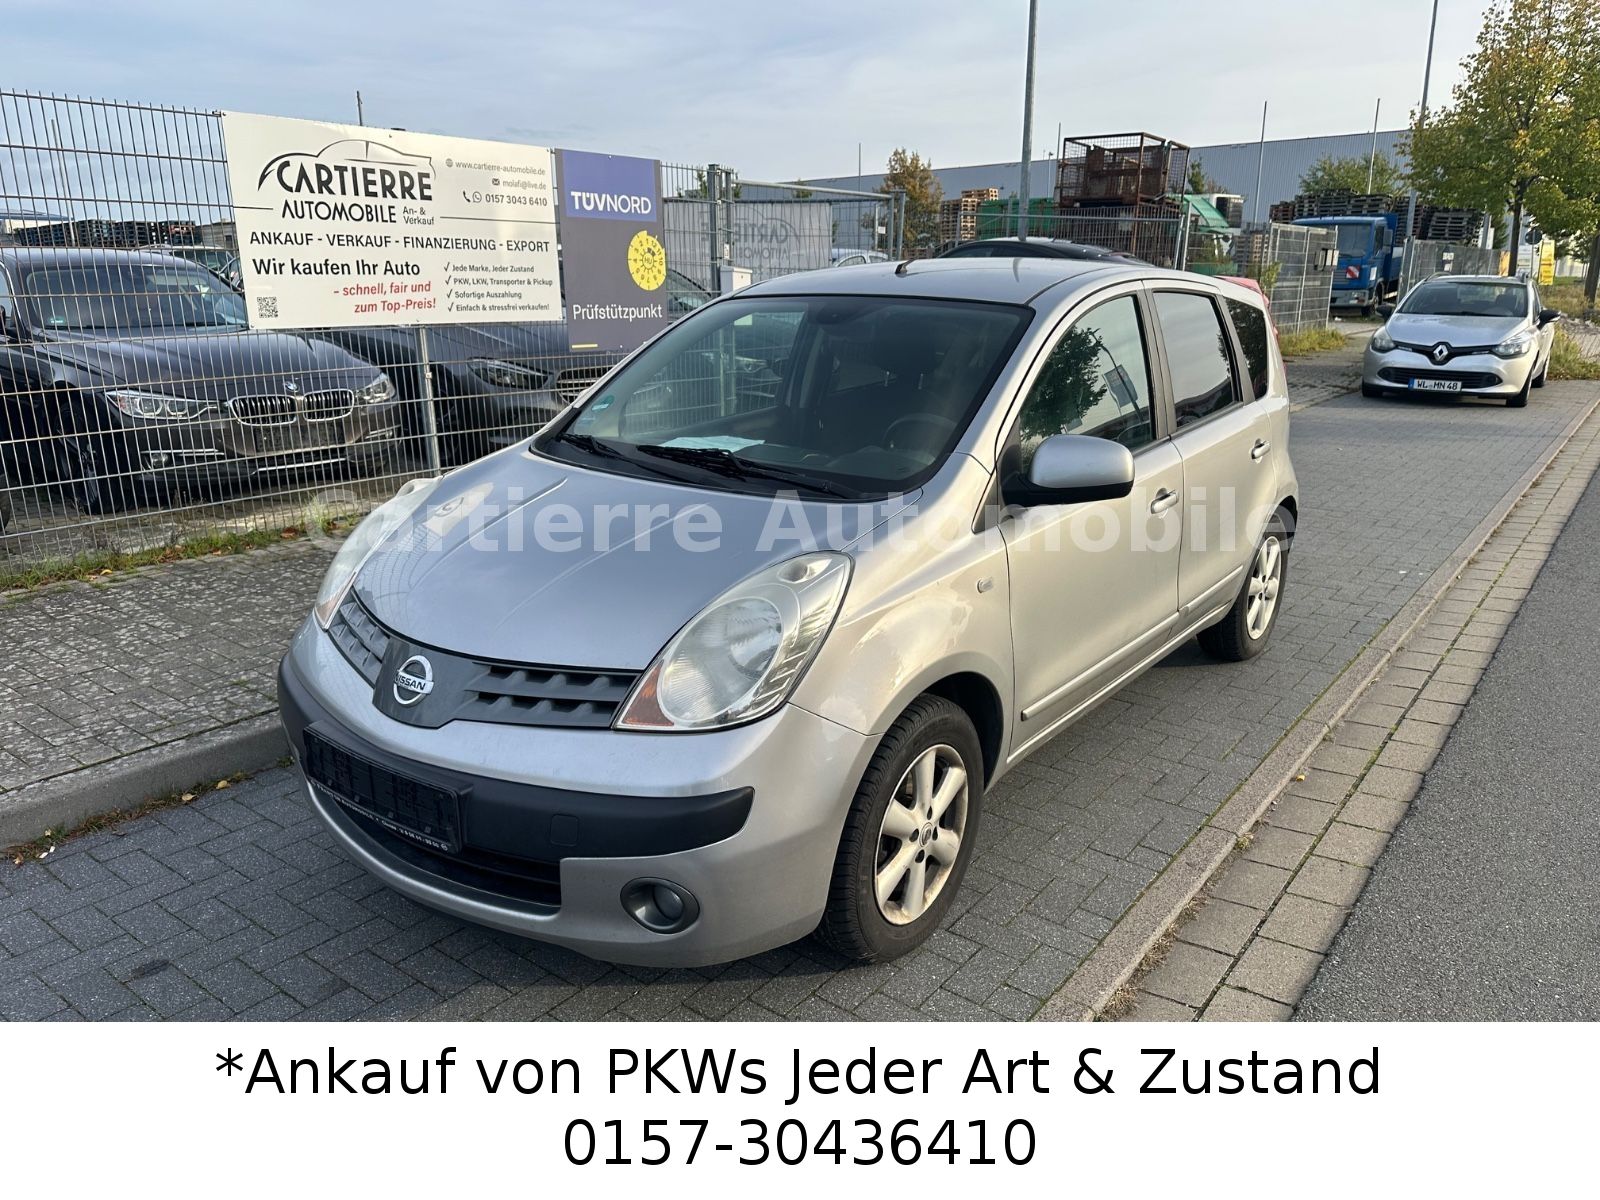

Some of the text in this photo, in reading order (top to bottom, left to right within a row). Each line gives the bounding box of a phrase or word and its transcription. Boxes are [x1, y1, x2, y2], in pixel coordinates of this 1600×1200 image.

[455, 160, 546, 176] www.cartierre-automobile.de
[276, 160, 433, 201] CARTIERRE
[485, 193, 548, 206] 0157 3043 6410
[281, 199, 397, 223] AUTOMOBILE
[402, 205, 426, 215] An- &
[403, 215, 434, 225] Verkauf
[250, 231, 314, 246] ANKAUF
[326, 234, 391, 248] VERKAUF
[403, 236, 497, 251] FINANZIERUNG
[506, 240, 550, 252] EXPORT
[252, 258, 421, 276] Wir kaufen Ihr Auto
[452, 264, 535, 273] Jede Marke, Jeder Zustand
[342, 282, 387, 296] schnell,
[389, 281, 409, 294] fair
[411, 281, 431, 293] und
[453, 277, 553, 287] PKW, LKW, Transporter & Pickup
[454, 291, 522, 299] Sofortige Auszahlung
[354, 298, 436, 314] zum Top-Preis!
[456, 303, 480, 312] Einfach
[488, 303, 518, 311] stressfrei
[518, 303, 550, 311] verkaufen!
[572, 303, 663, 322] Prüfstützpunkt
[1447, 382, 1458, 391] 48
